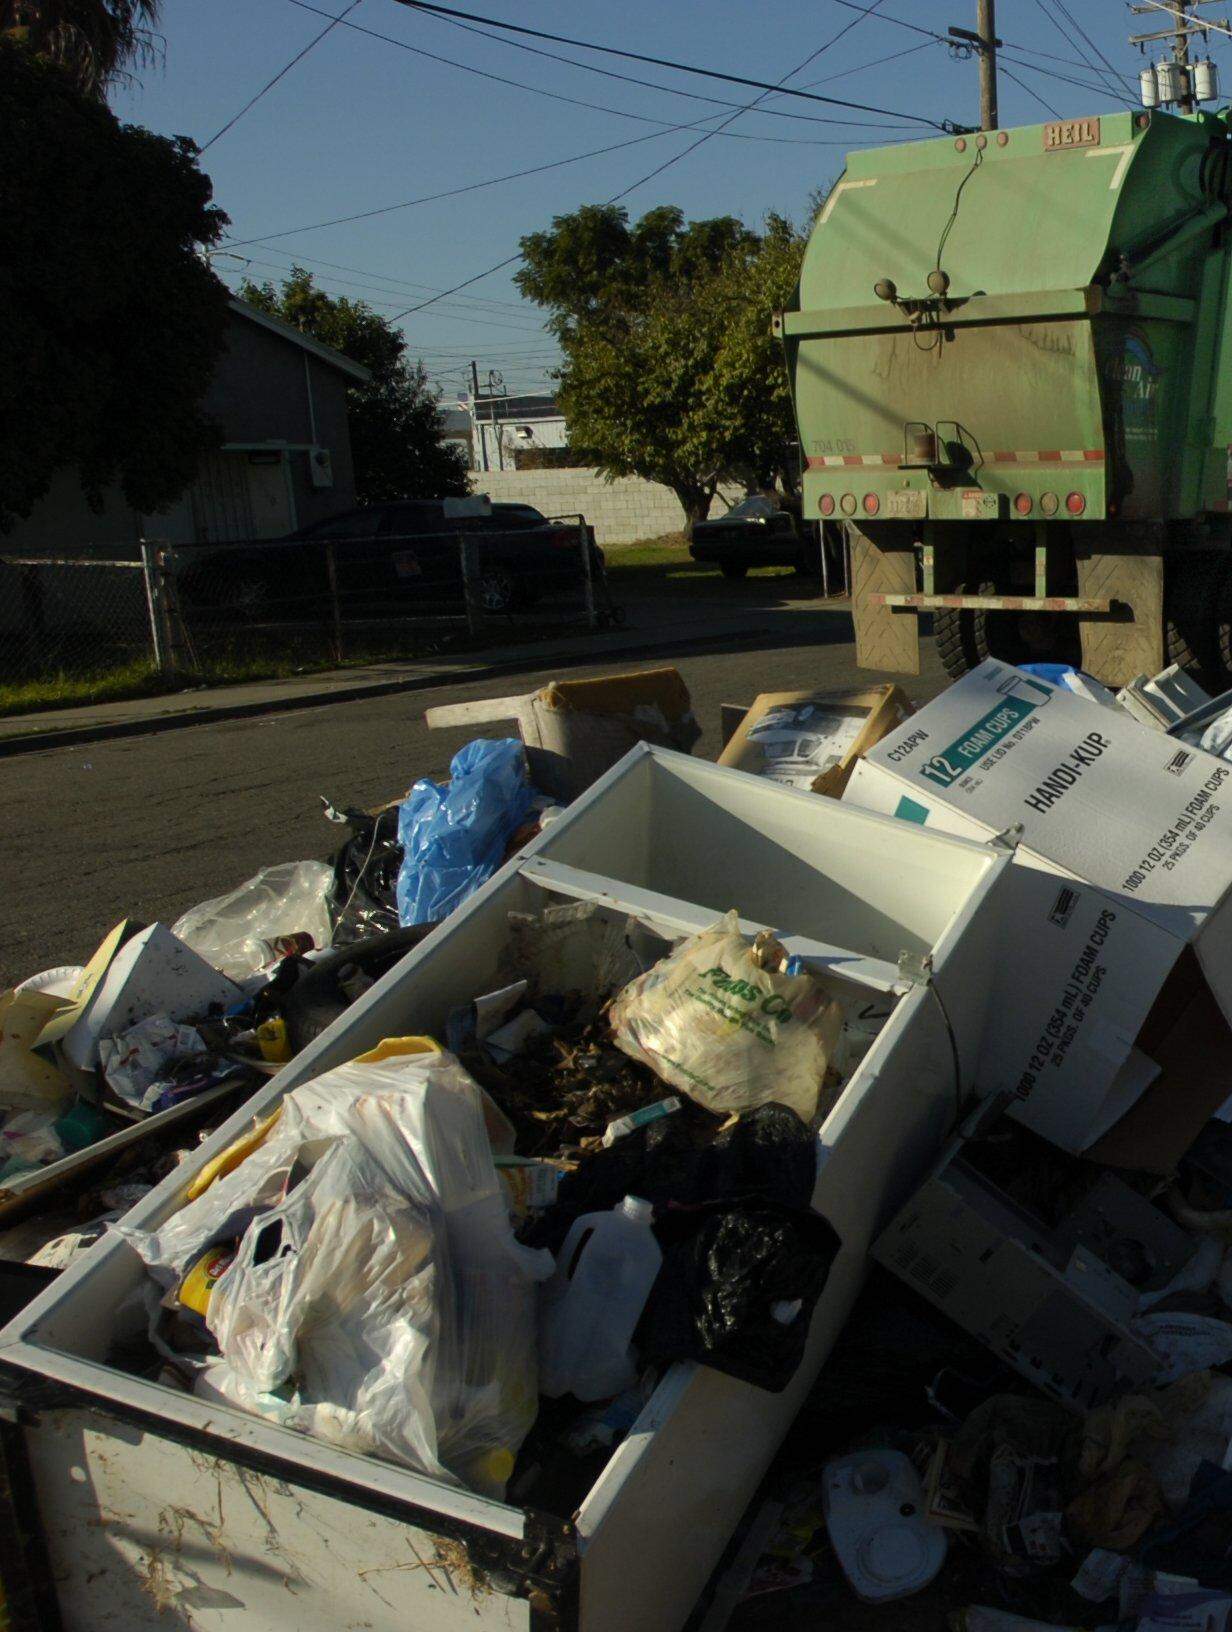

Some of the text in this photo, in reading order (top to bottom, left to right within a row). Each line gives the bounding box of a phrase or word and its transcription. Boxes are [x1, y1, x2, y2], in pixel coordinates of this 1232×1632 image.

[1048, 123, 1095, 146] HEIL
[887, 728, 930, 762] C12APW
[921, 754, 963, 782] 12
[957, 724, 994, 758] FOAM
[986, 707, 1020, 734] CUPS
[1122, 767, 1230, 893] 1000 12 OZ (354 mL) FOAM CUPS
[1162, 858, 1175, 871] 25
[1185, 829, 1199, 841] OF
[1194, 820, 1204, 832] 40
[1201, 804, 1220, 823] CUPS
[1087, 965, 1107, 995] CUPS
[1015, 909, 1116, 1102] 1000 12 OZ (354 mL) FOAM CUPS
[1073, 1008, 1086, 1022] OF
[1084, 993, 1094, 1007] 40
[1051, 1054, 1064, 1068] 25
